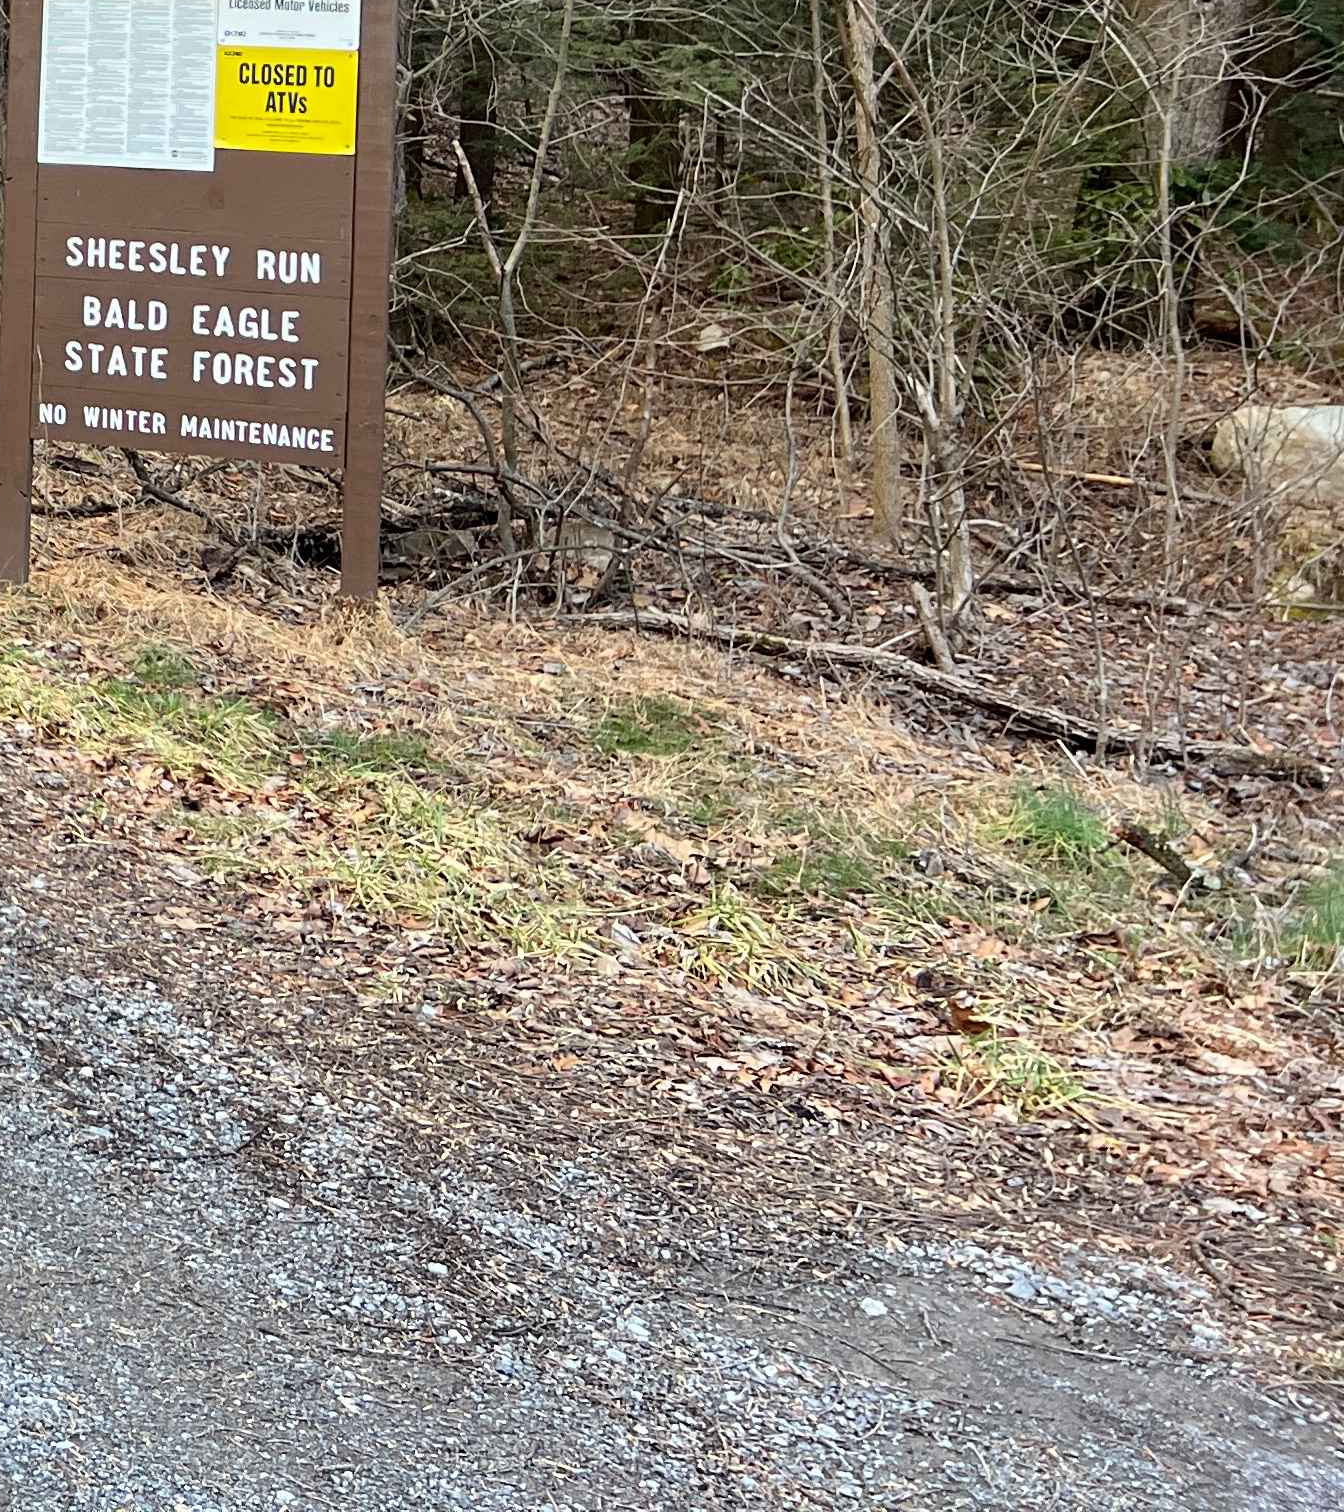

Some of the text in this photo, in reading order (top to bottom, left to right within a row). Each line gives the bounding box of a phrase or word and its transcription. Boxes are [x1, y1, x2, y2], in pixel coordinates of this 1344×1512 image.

[308, 0, 350, 13] Vehicles
[239, 62, 335, 88] CLOSED TO
[265, 91, 307, 114] ATVs
[65, 236, 321, 284] SHEESLEY RUN
[82, 295, 301, 343] BALD EAGLE
[64, 340, 319, 390] STATE FOREST
[39, 402, 335, 452] NO WINTER MAINTENANCE
